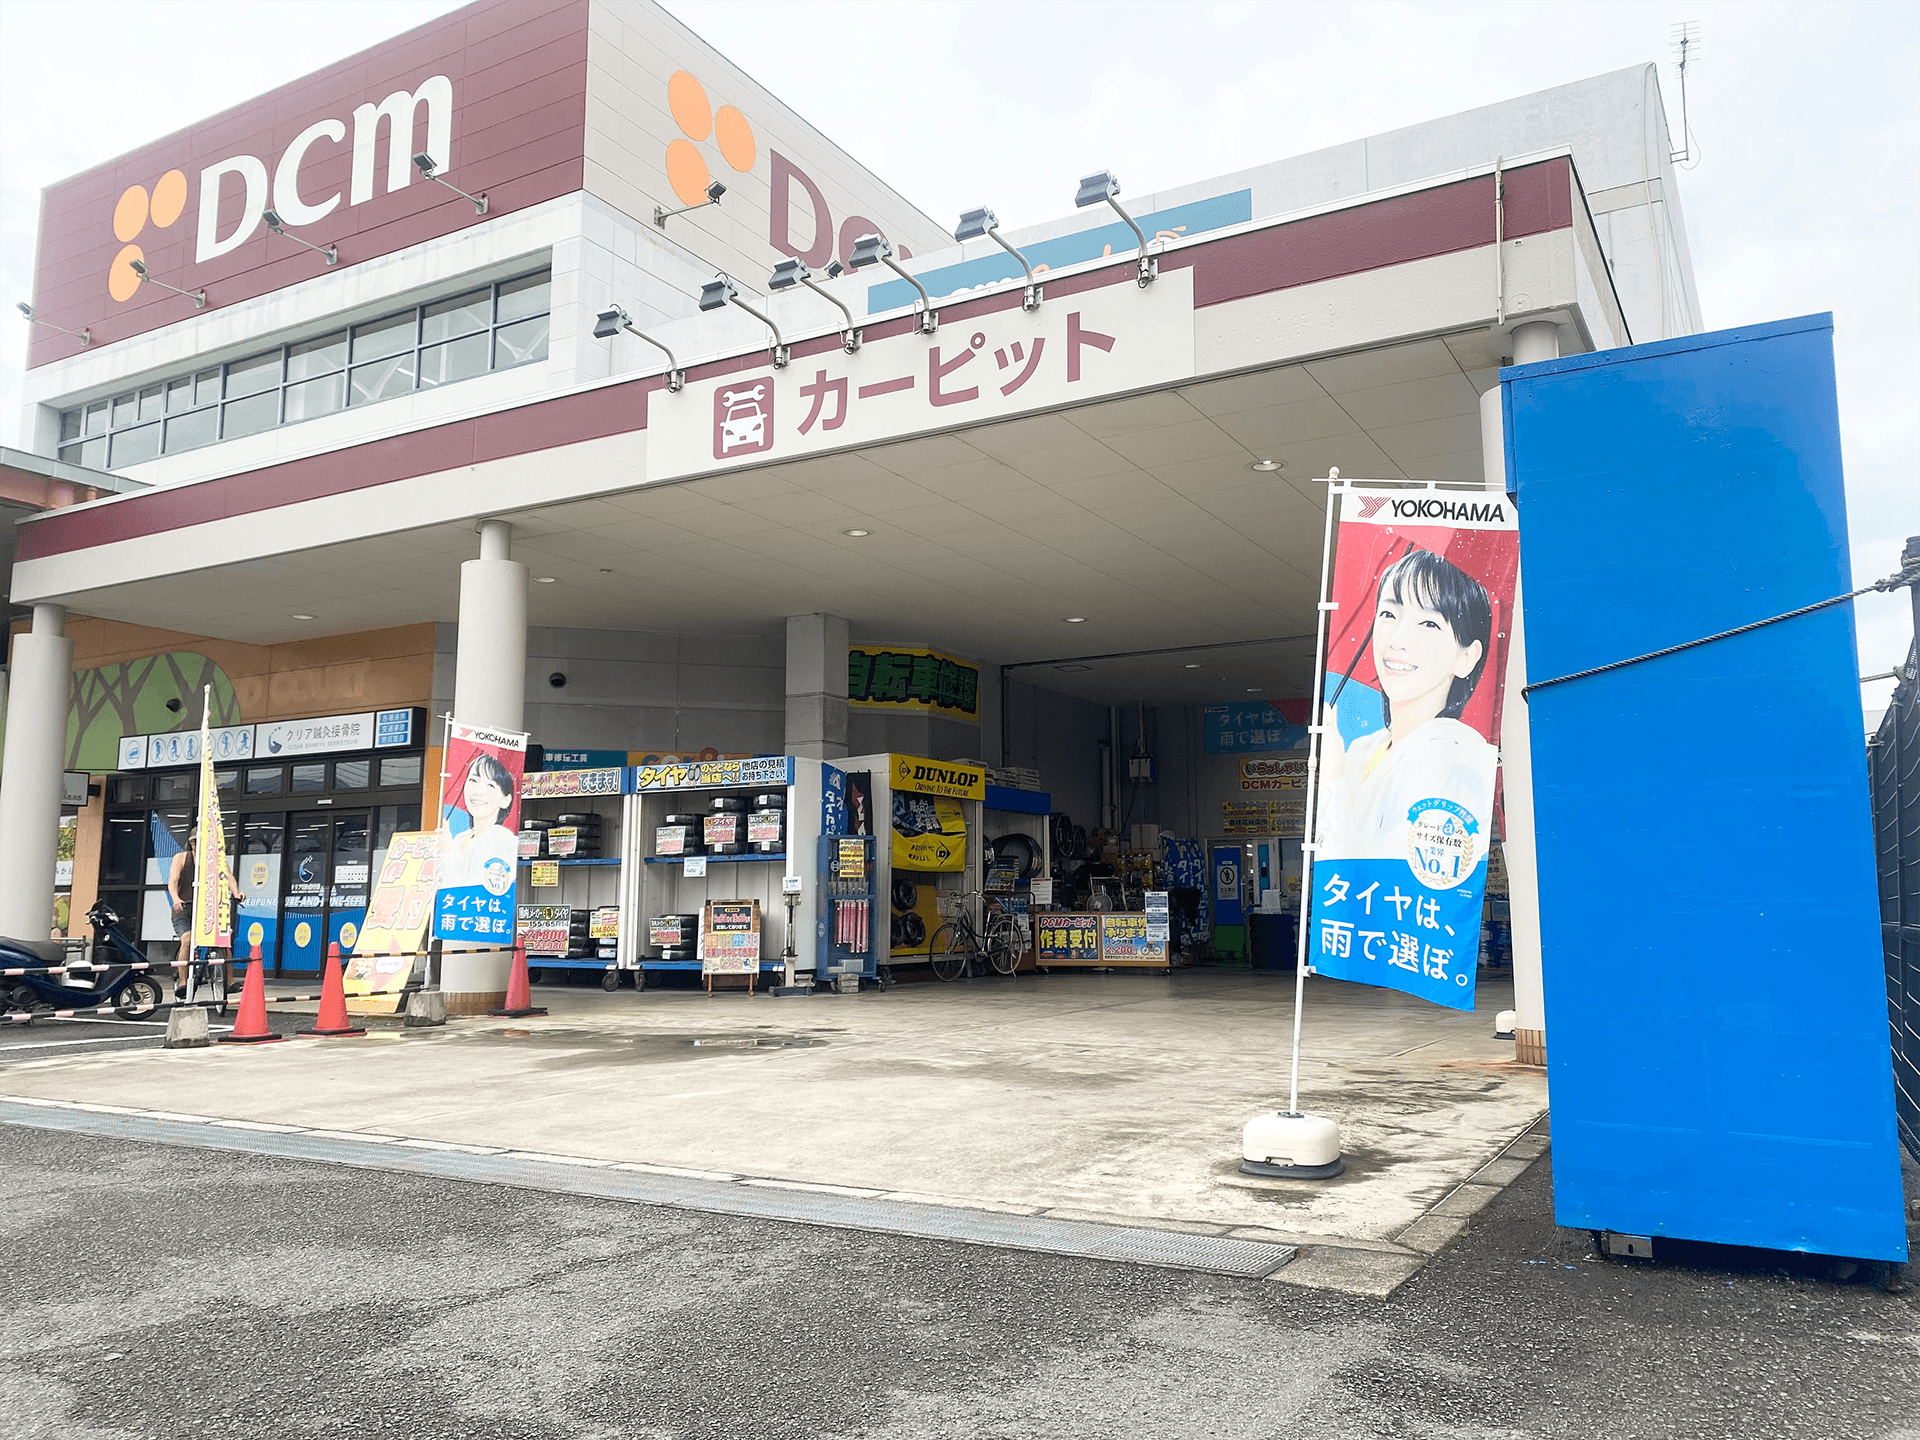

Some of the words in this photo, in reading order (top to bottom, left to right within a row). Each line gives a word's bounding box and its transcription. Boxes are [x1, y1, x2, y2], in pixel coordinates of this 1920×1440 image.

[797, 311, 1116, 436] カーピット
[1391, 499, 1505, 522] YOKOHAMA
[286, 722, 361, 742] クリア鍼灸接骨院
[474, 731, 520, 748] YOKOHAMA
[543, 752, 588, 763] 車修理工賃
[701, 762, 740, 773] のことなら
[742, 759, 785, 770] 他店の見積
[639, 764, 686, 787] タイヤ
[700, 772, 740, 784] 当店へ!!
[742, 769, 786, 781] お持ち下さい!
[913, 765, 979, 787] DUNLOP
[1244, 761, 1309, 776] いらっしゃい
[914, 782, 936, 793] DRIVING
[936, 784, 943, 794] TO
[943, 785, 953, 795] THE
[952, 786, 969, 798] FUTURE
[1242, 780, 1308, 790] DCMカーピッ
[1411, 799, 1475, 825] ウェットグリップ性能
[388, 837, 438, 860] カーピッ
[1416, 832, 1462, 848] サイズ保有数
[367, 885, 432, 930] 受付
[442, 894, 507, 915] タイヤは、
[1322, 873, 1456, 937] タイヤは、
[1040, 917, 1097, 928] DCMカーピット
[1040, 929, 1097, 949] 作業受付
[1321, 919, 1468, 987] 雨で選ぼ。
